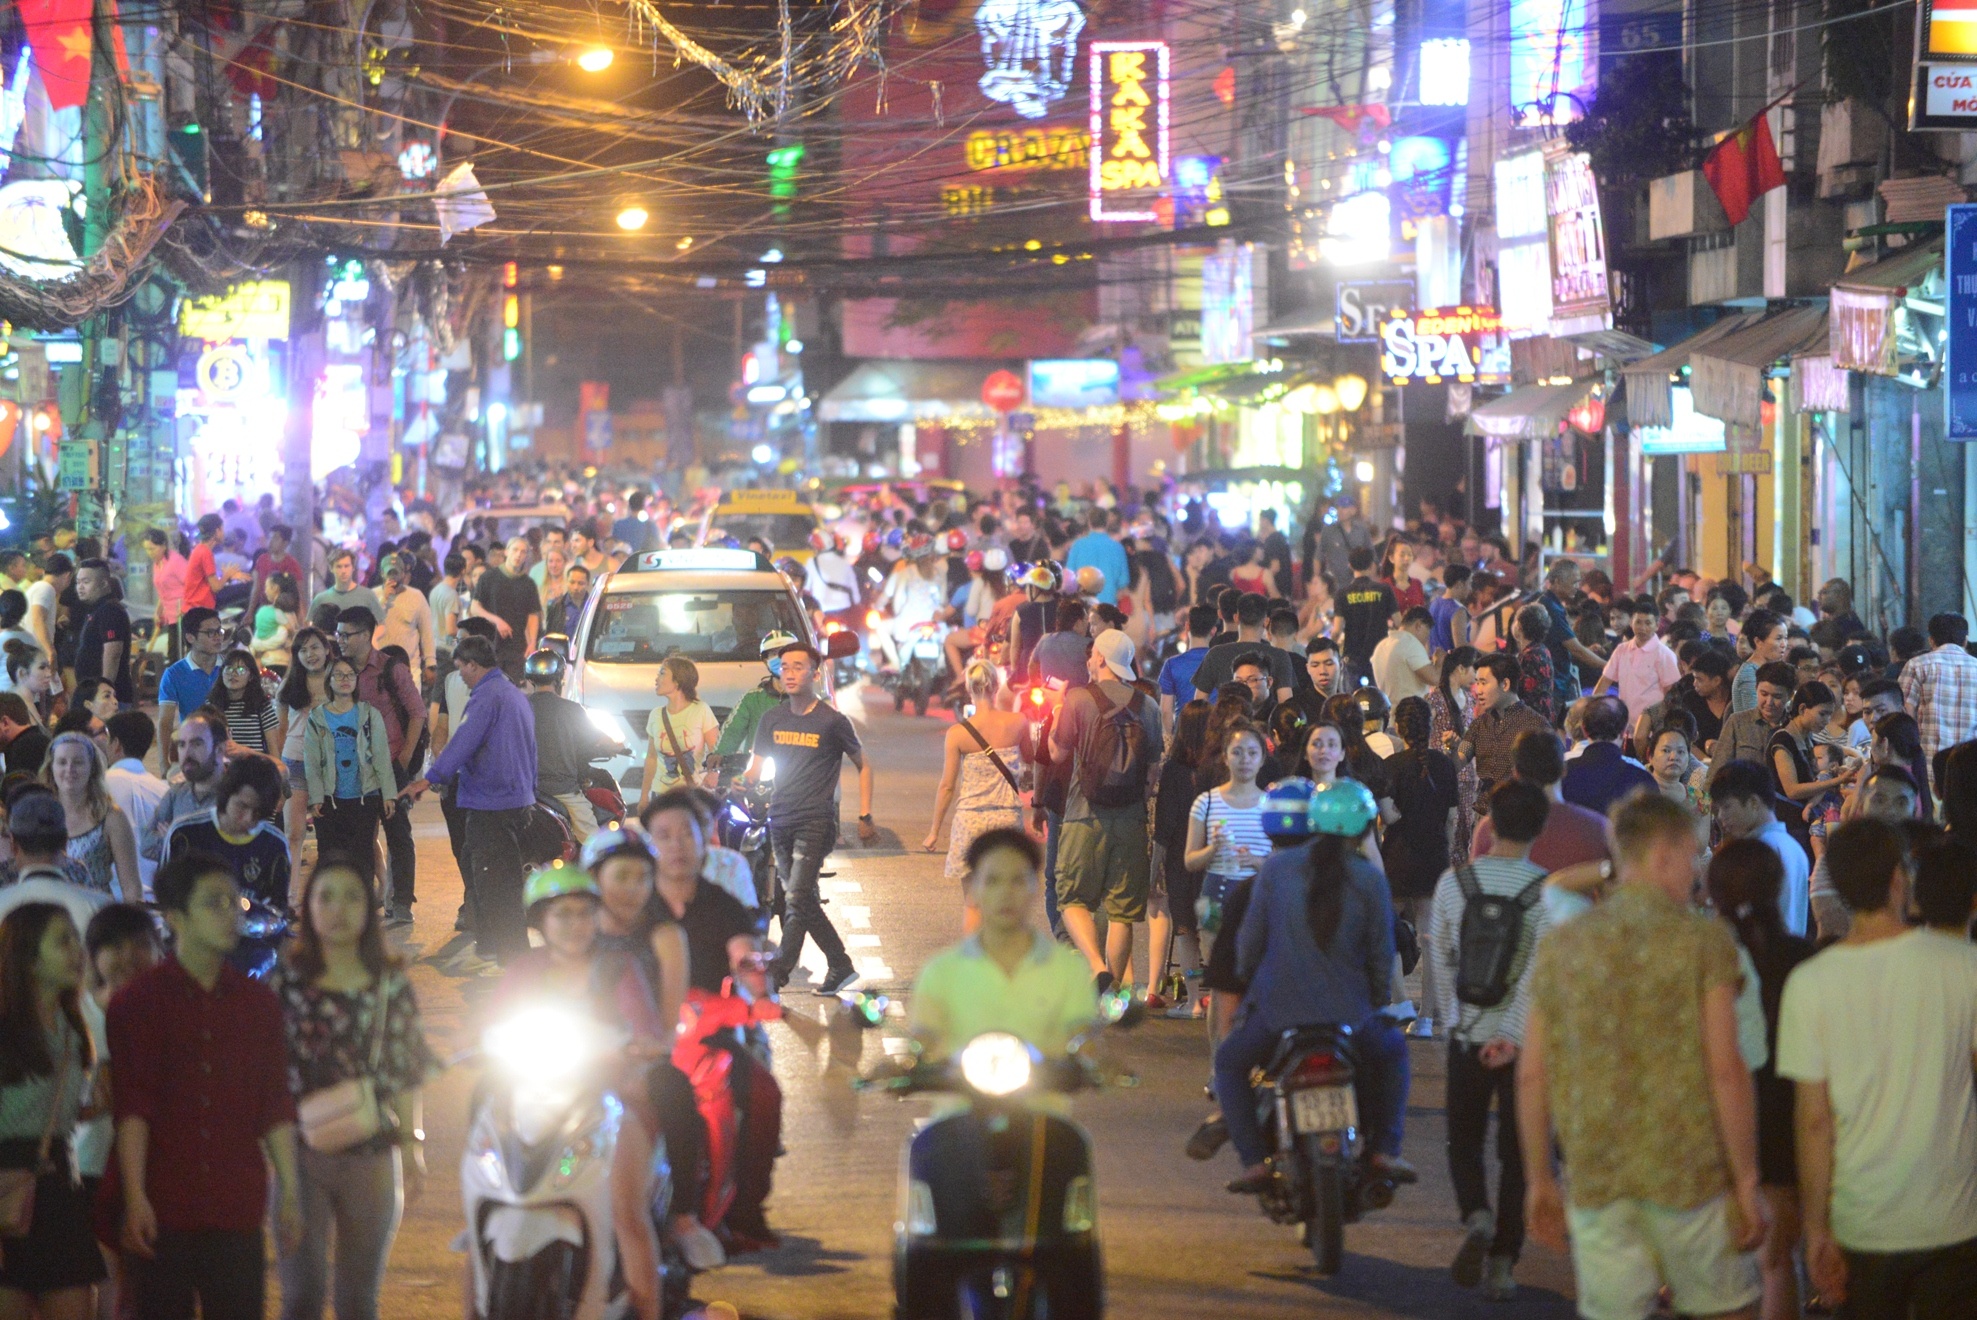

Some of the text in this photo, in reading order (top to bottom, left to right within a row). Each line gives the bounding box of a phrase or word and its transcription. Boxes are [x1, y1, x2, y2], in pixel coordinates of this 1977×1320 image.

[1934, 71, 1972, 88] CỬA
[1109, 52, 1152, 158] KAKA
[1101, 158, 1162, 190] SPA
[1416, 315, 1473, 335] EDEN
[1385, 318, 1476, 378] SPA
[1347, 590, 1382, 604] SECURITY
[773, 730, 820, 748] COURAGE
